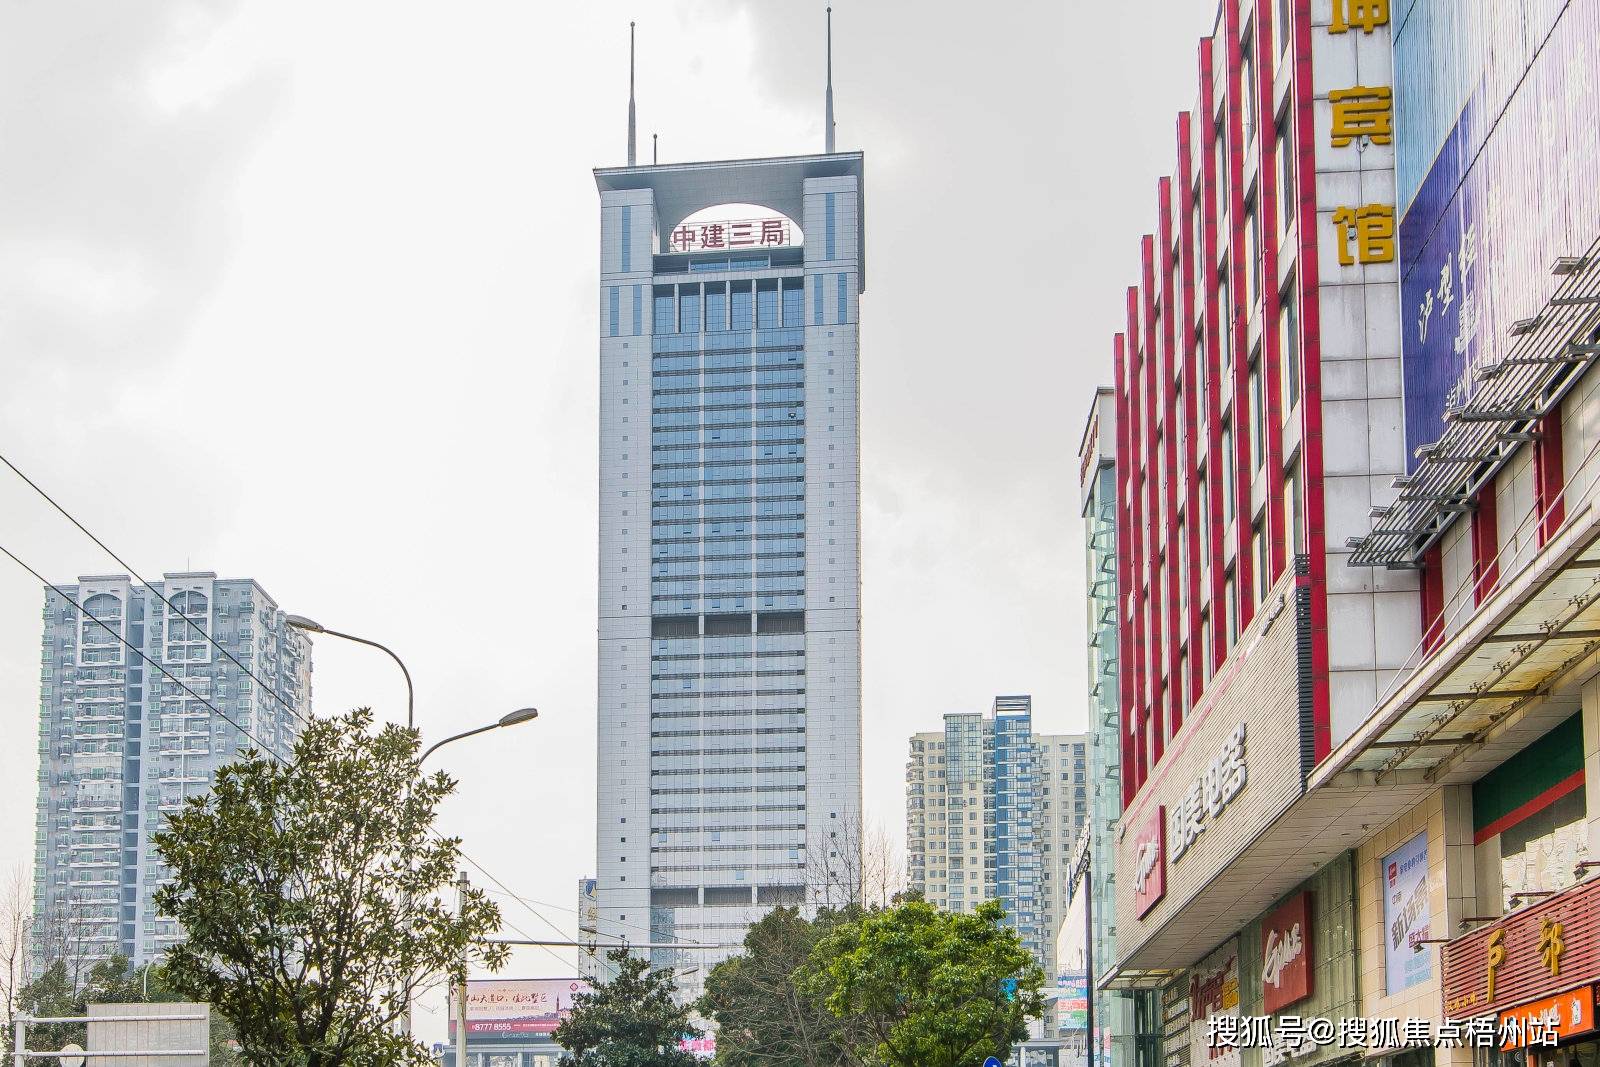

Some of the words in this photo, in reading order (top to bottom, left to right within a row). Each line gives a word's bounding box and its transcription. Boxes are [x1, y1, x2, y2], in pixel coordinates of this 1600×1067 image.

[673, 219, 784, 251] 中建三局
[1171, 720, 1246, 864] 国美电器
[475, 1023, 492, 1031] 8777
[494, 1023, 512, 1031] 8555
